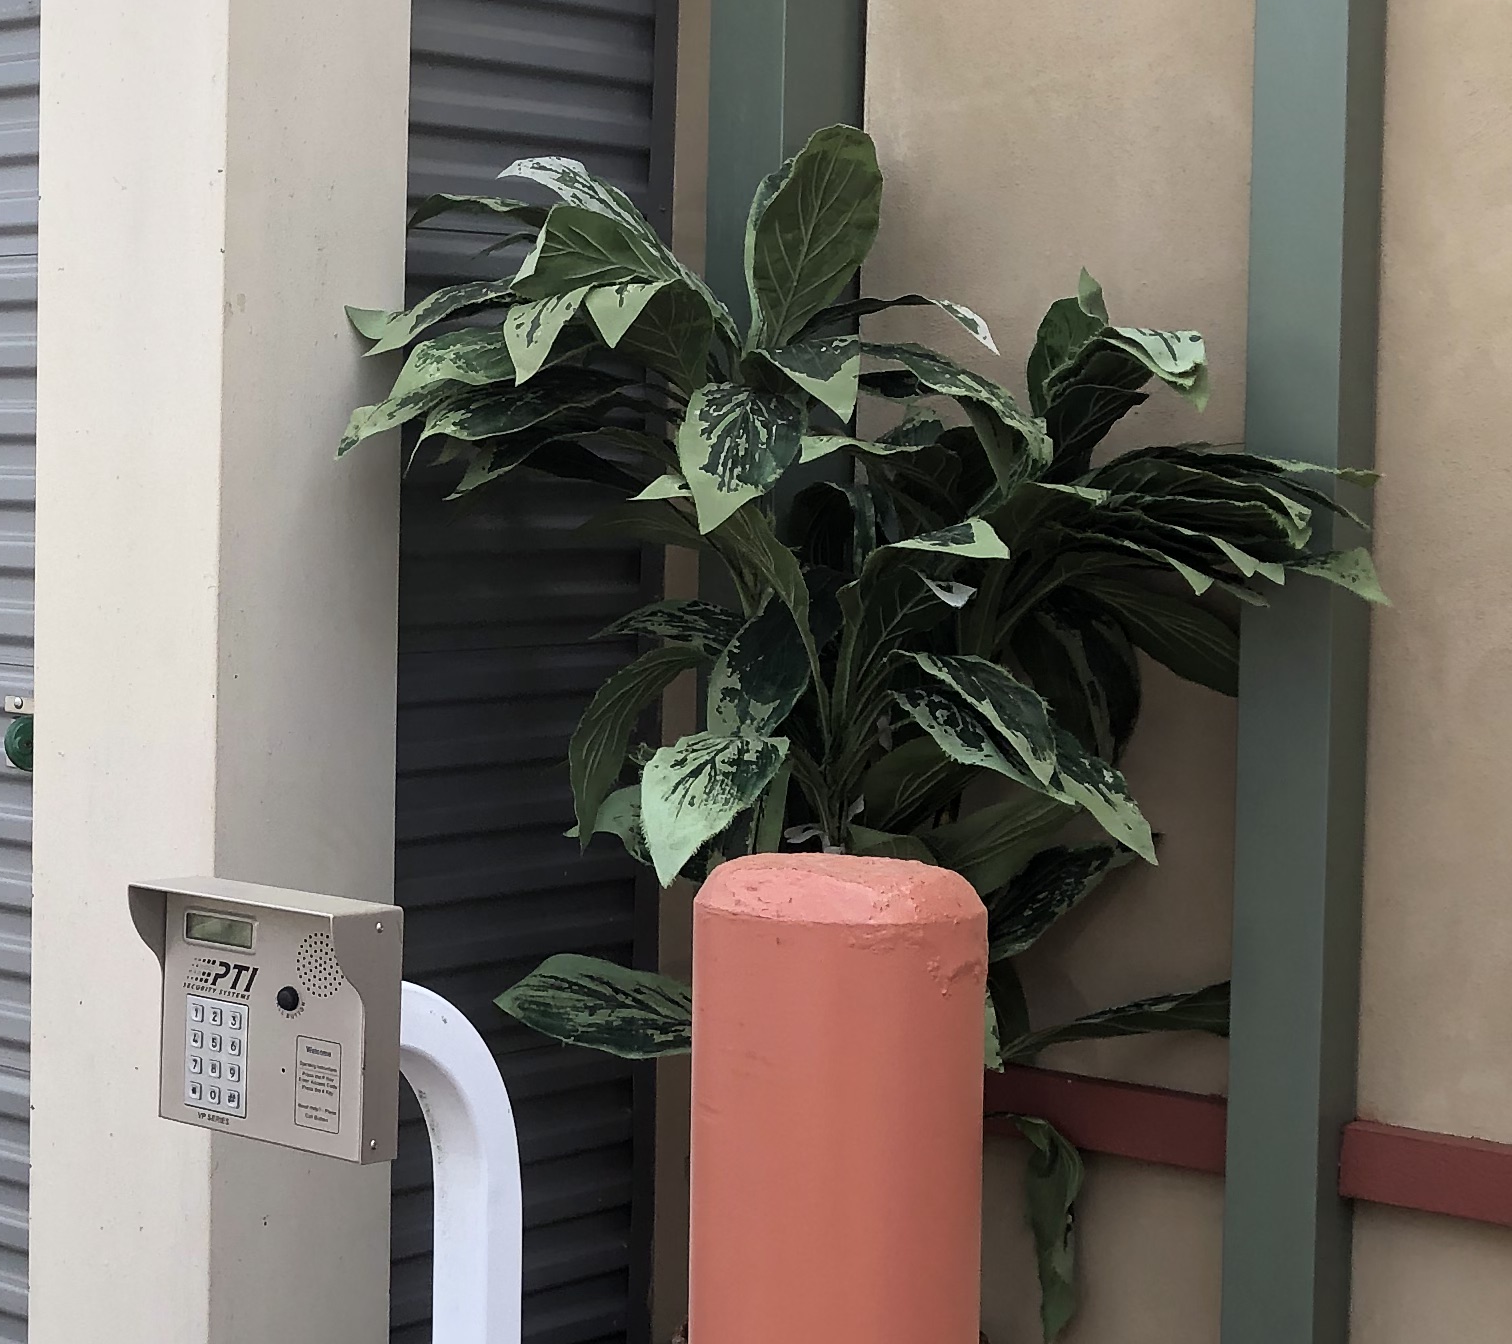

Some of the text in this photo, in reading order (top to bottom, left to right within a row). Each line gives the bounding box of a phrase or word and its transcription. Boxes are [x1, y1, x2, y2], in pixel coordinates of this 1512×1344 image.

[210, 961, 259, 992] PTI
[183, 982, 251, 1000] SECURITY SYSTEMS
[211, 1011, 218, 1023] 2
[230, 1015, 237, 1027] 3
[192, 1033, 237, 1052] 4 5 6
[192, 1058, 236, 1079] 7 8 9
[209, 1089, 217, 1101] 0
[208, 1114, 230, 1125] SERIES
